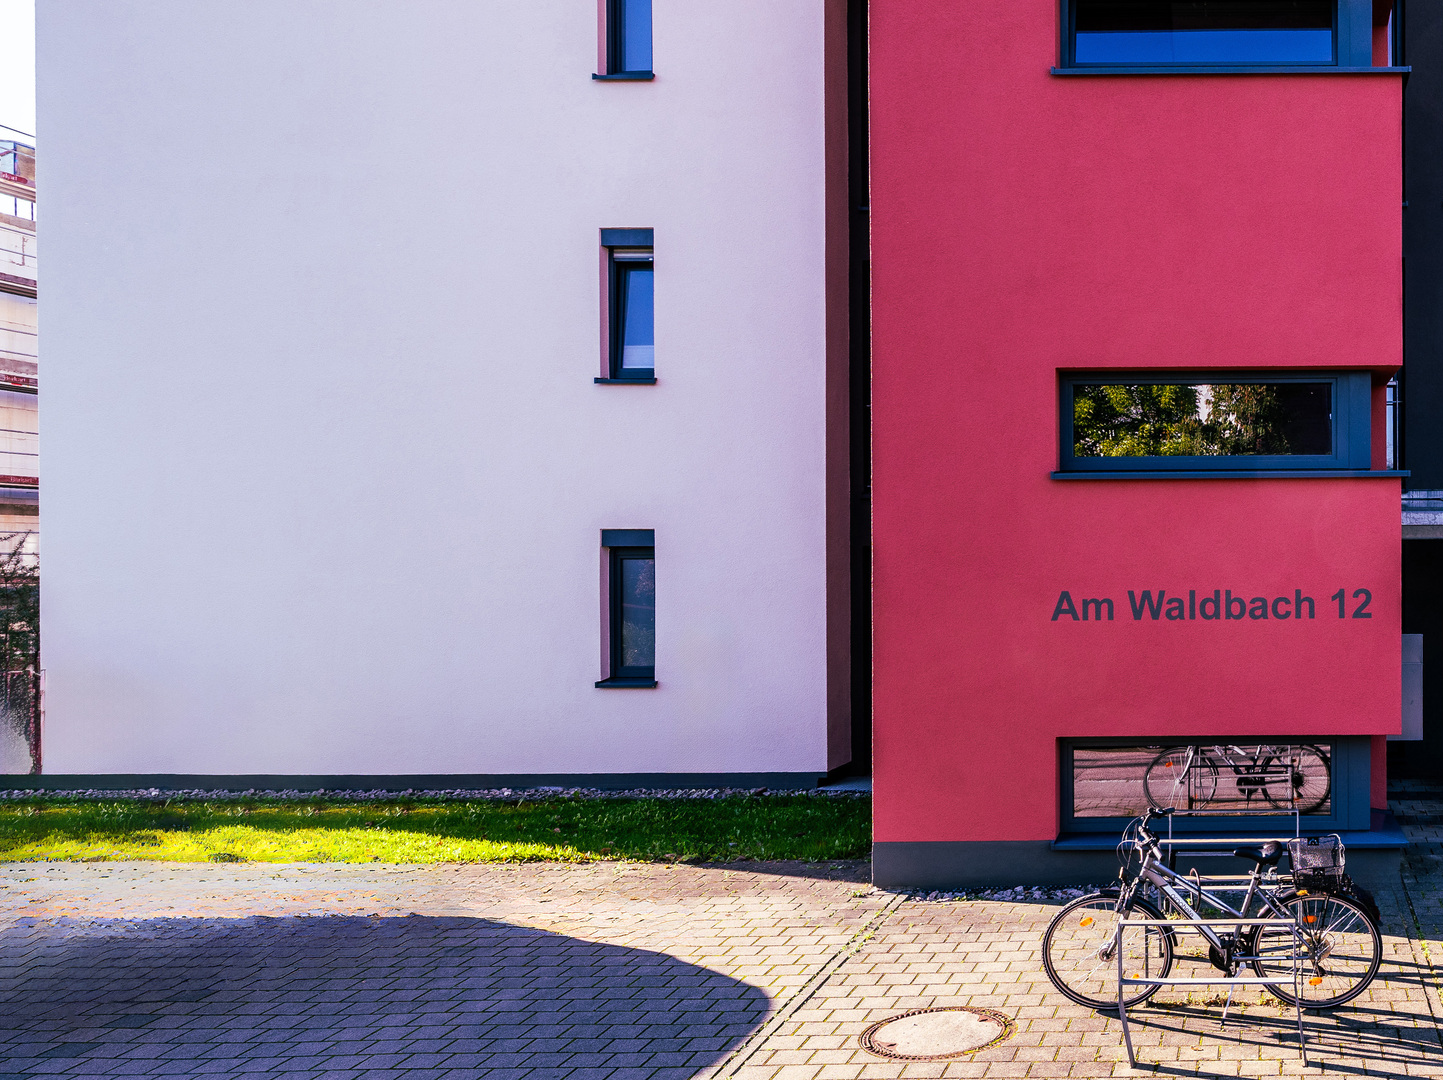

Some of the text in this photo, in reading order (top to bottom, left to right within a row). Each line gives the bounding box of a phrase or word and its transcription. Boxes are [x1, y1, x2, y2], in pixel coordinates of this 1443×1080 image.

[1051, 588, 1373, 621] Am Waldbach 12
